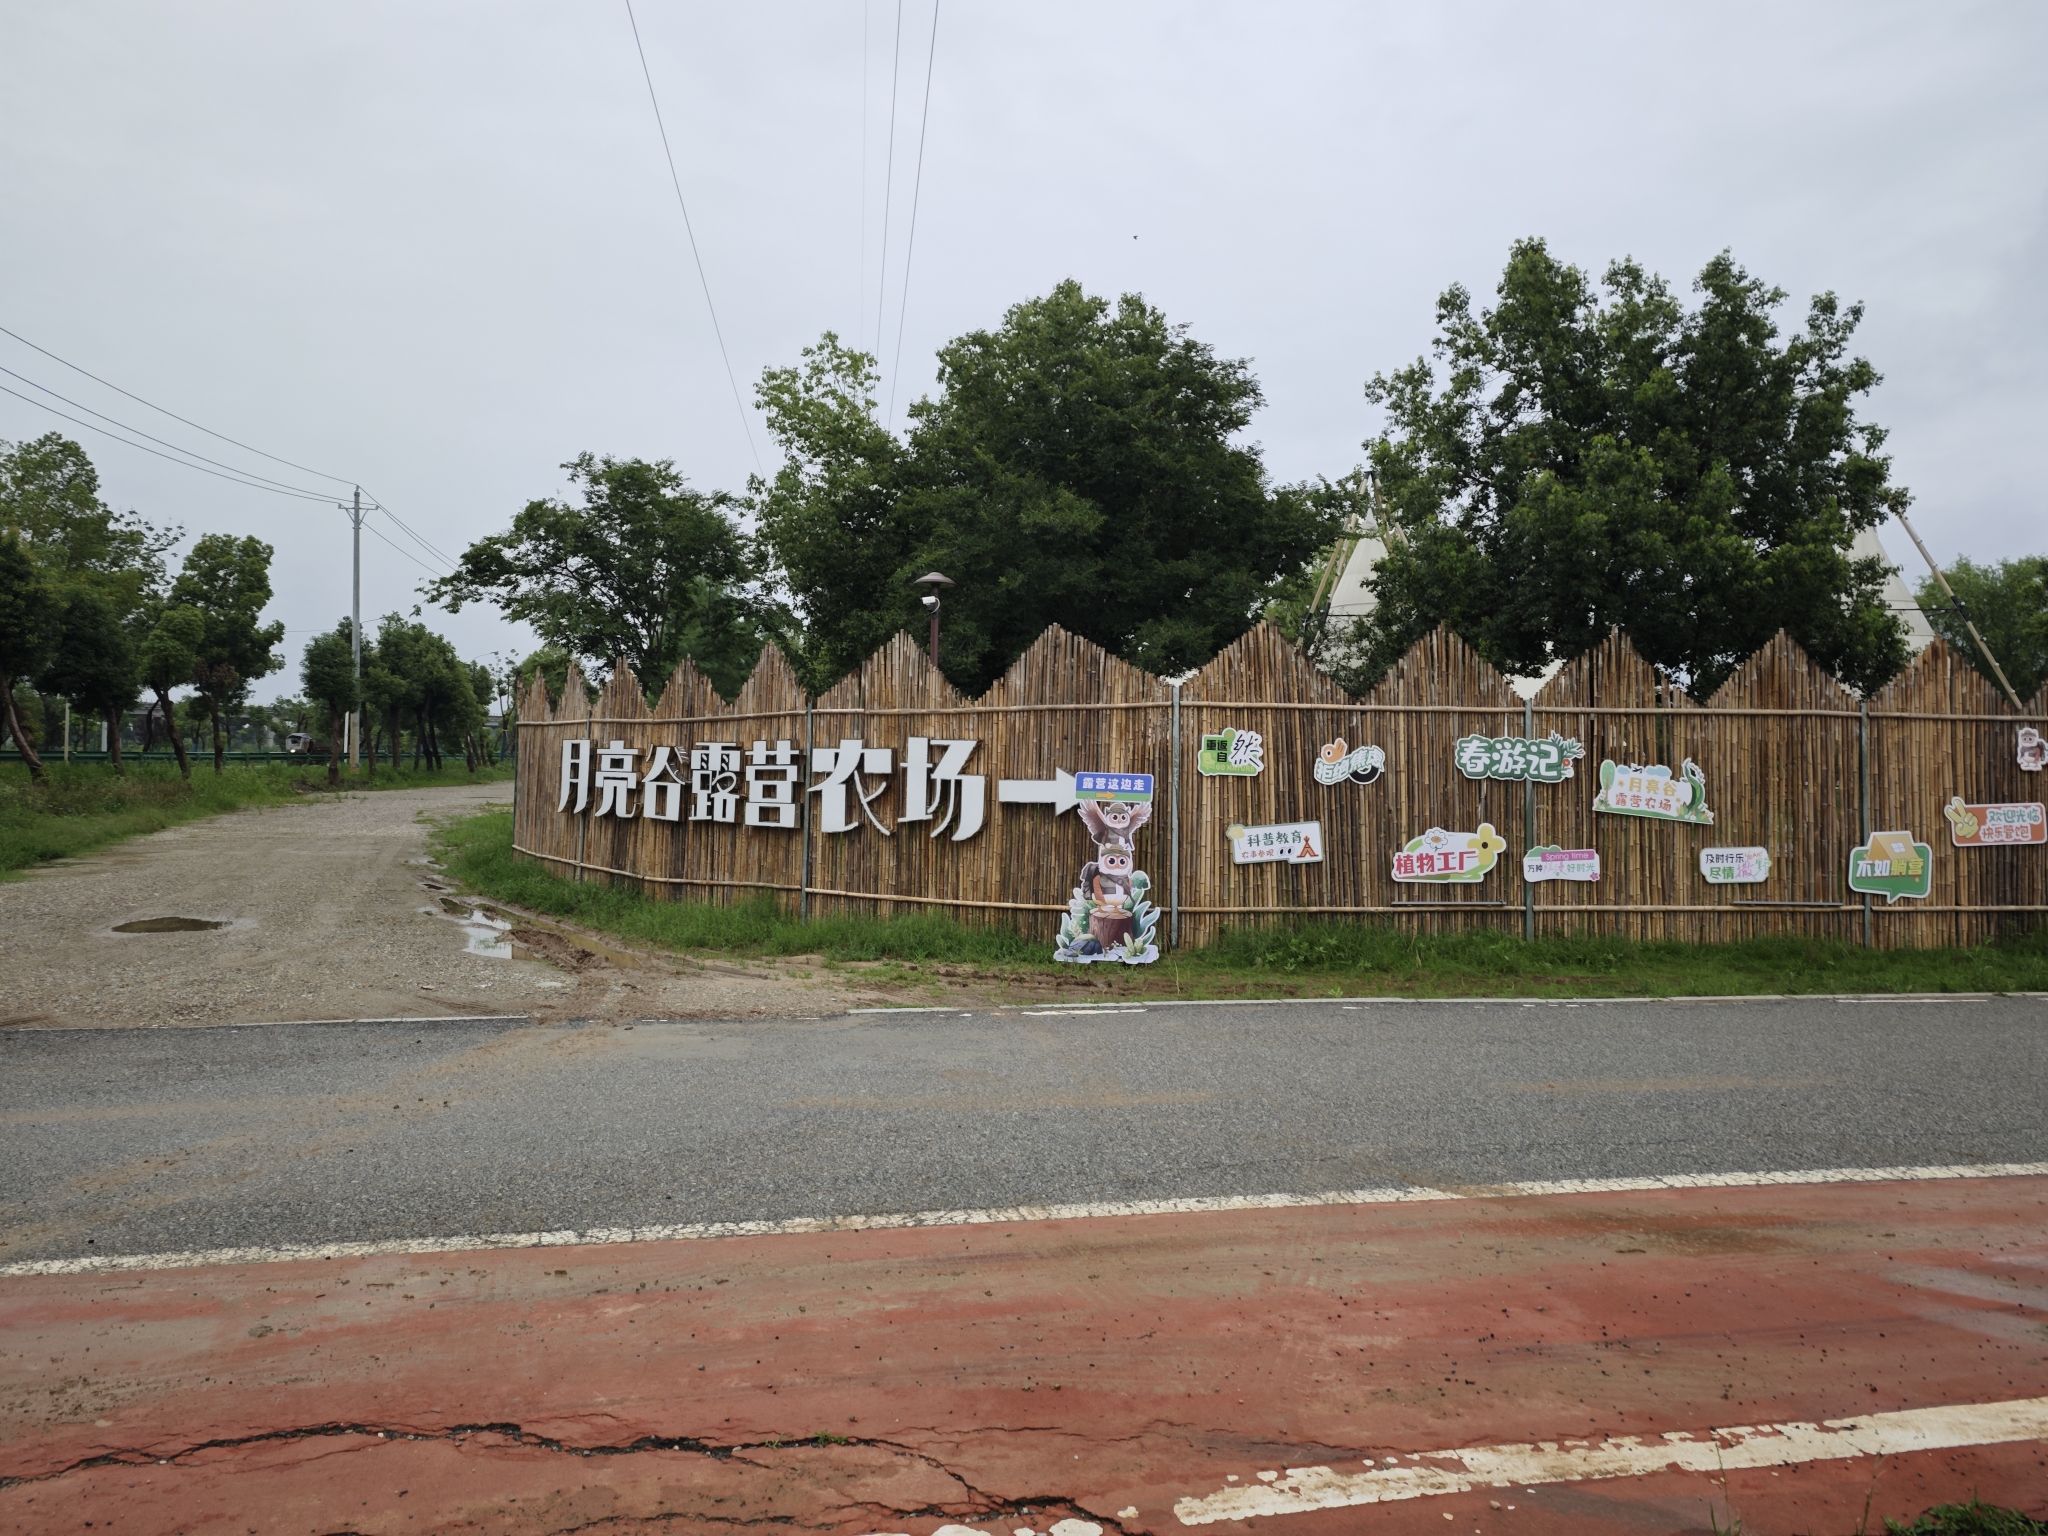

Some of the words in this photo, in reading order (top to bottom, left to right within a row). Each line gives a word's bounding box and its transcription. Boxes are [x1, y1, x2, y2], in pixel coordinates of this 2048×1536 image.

[1206, 739, 1228, 751] 重返
[1460, 740, 1558, 777] 春游记
[557, 737, 985, 841] 月亮谷露营农场
[1083, 777, 1144, 790] 露营这边走
[1628, 777, 1677, 797] 月亮谷
[1615, 793, 1672, 812] 露营农场
[1988, 806, 2040, 824] 欢迎光临
[1247, 830, 1302, 847] 科普教育
[1981, 825, 2030, 839] 快乐管饱
[1395, 850, 1476, 875] 植物工厂
[1705, 853, 1744, 864] 及时行乐
[1527, 862, 1596, 874] 万种好时光
